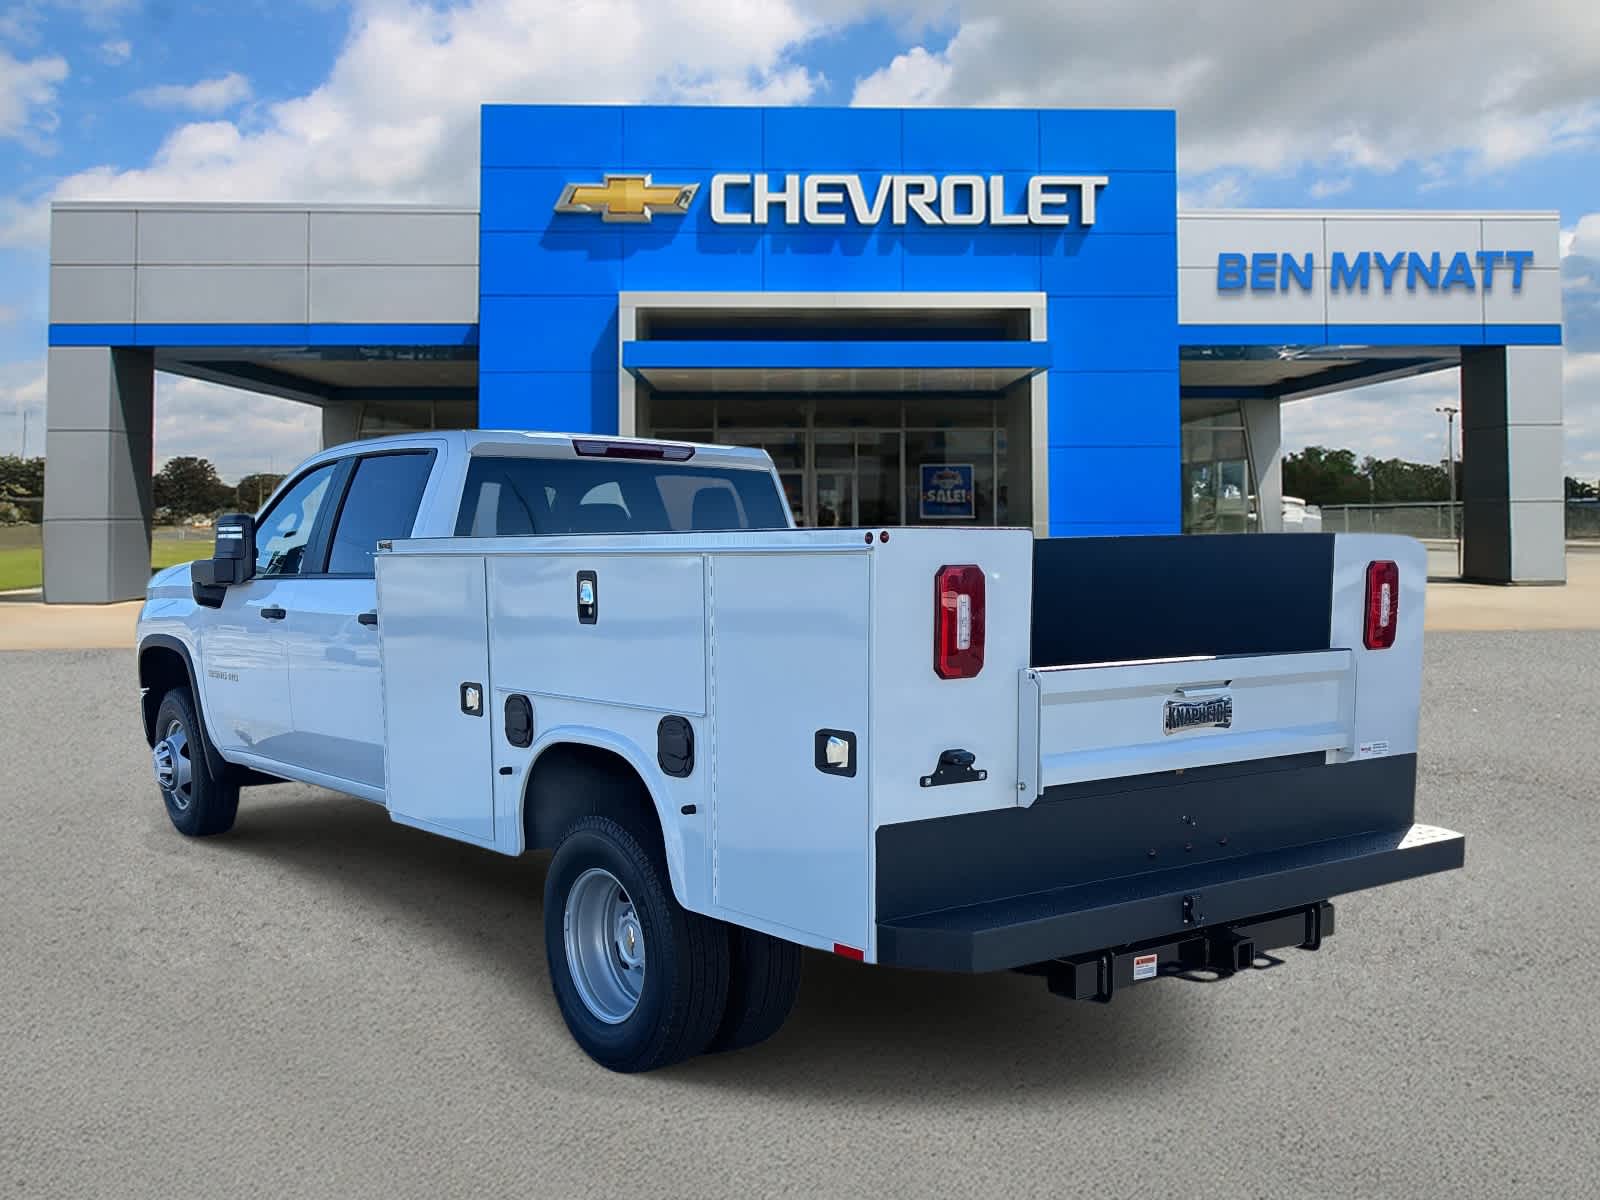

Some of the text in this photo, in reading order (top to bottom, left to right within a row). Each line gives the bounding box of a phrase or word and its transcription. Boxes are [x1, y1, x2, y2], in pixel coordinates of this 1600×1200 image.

[710, 173, 1109, 225] CHEVROLET
[1217, 250, 1534, 290] BEN MYNATT
[1167, 703, 1232, 729] KNAPHEIDE
